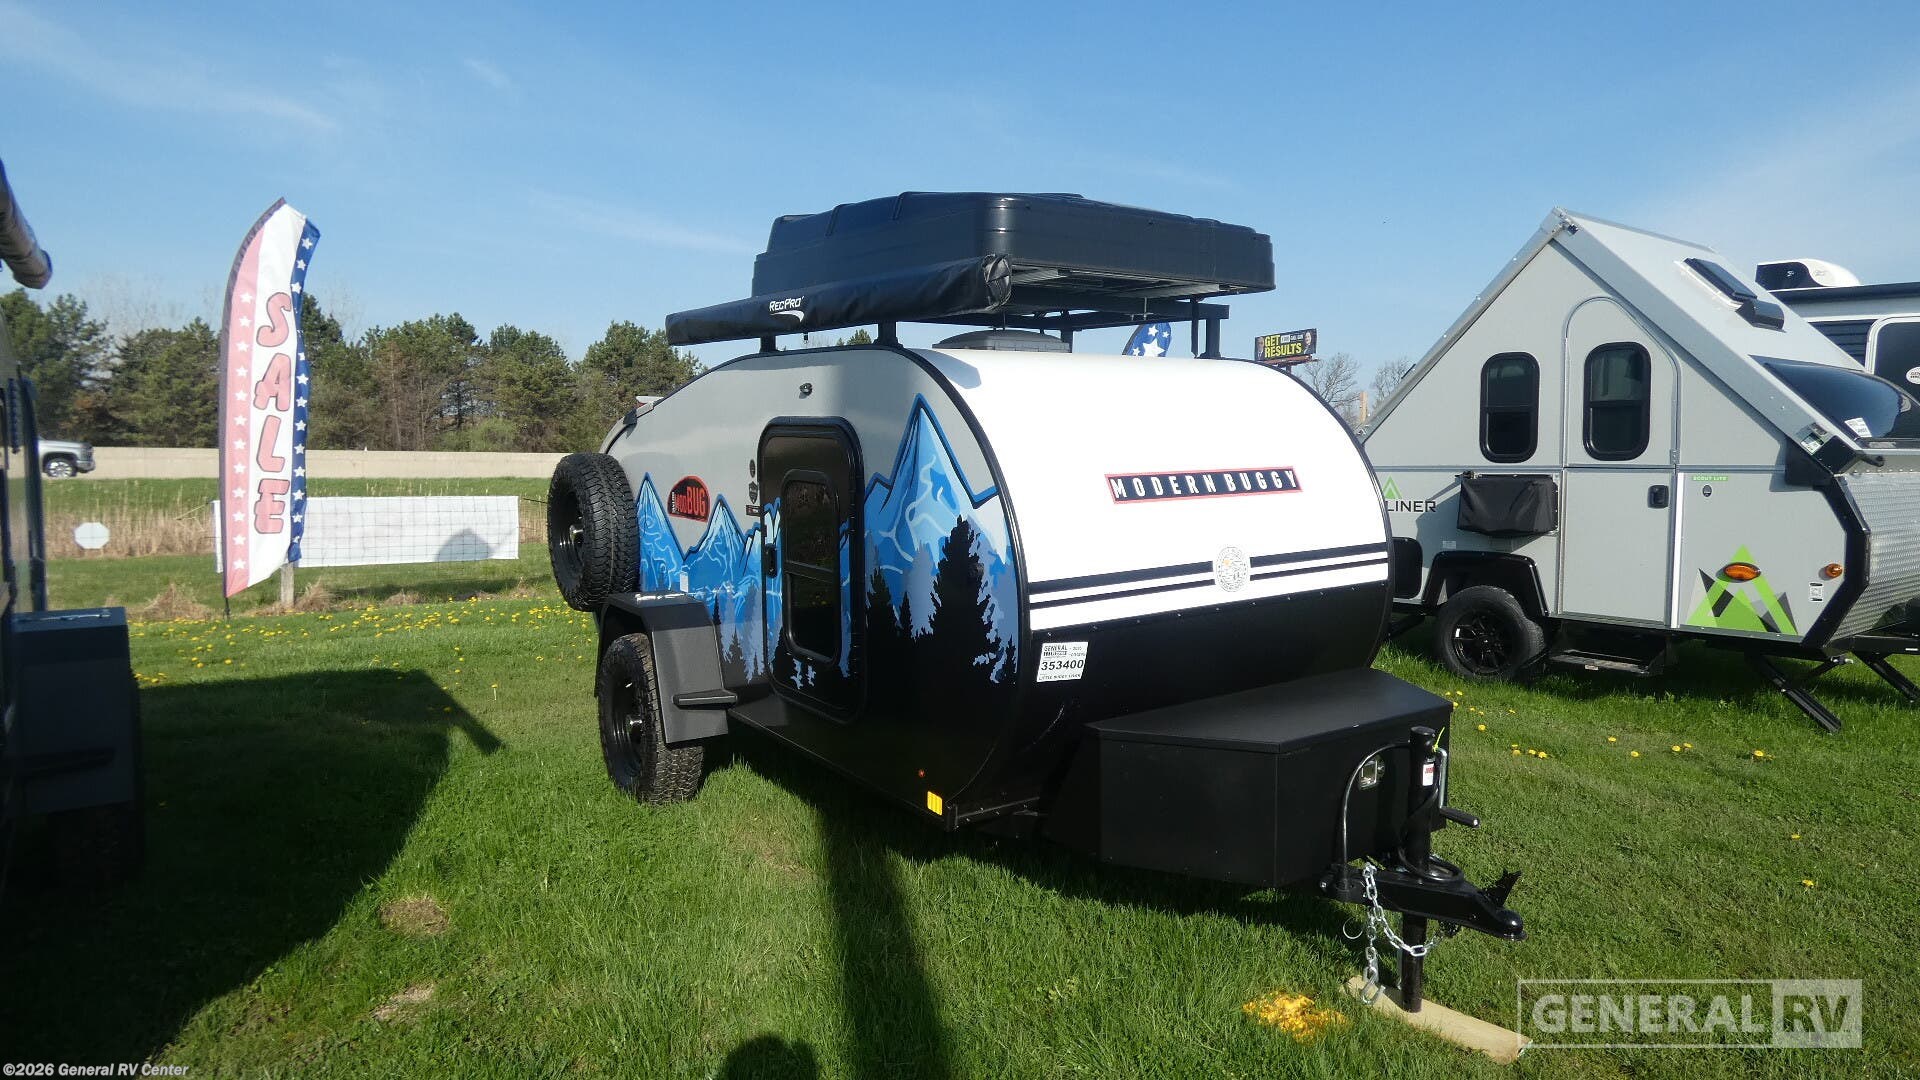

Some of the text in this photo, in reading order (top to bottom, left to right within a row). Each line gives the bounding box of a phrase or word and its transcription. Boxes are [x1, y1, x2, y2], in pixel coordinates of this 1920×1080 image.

[1265, 335, 1280, 347] GET
[1264, 343, 1302, 358] RESULTS
[253, 292, 292, 534] SALE
[1110, 470, 1297, 498] MODERN BUGGY
[1041, 660, 1084, 670] 353400
